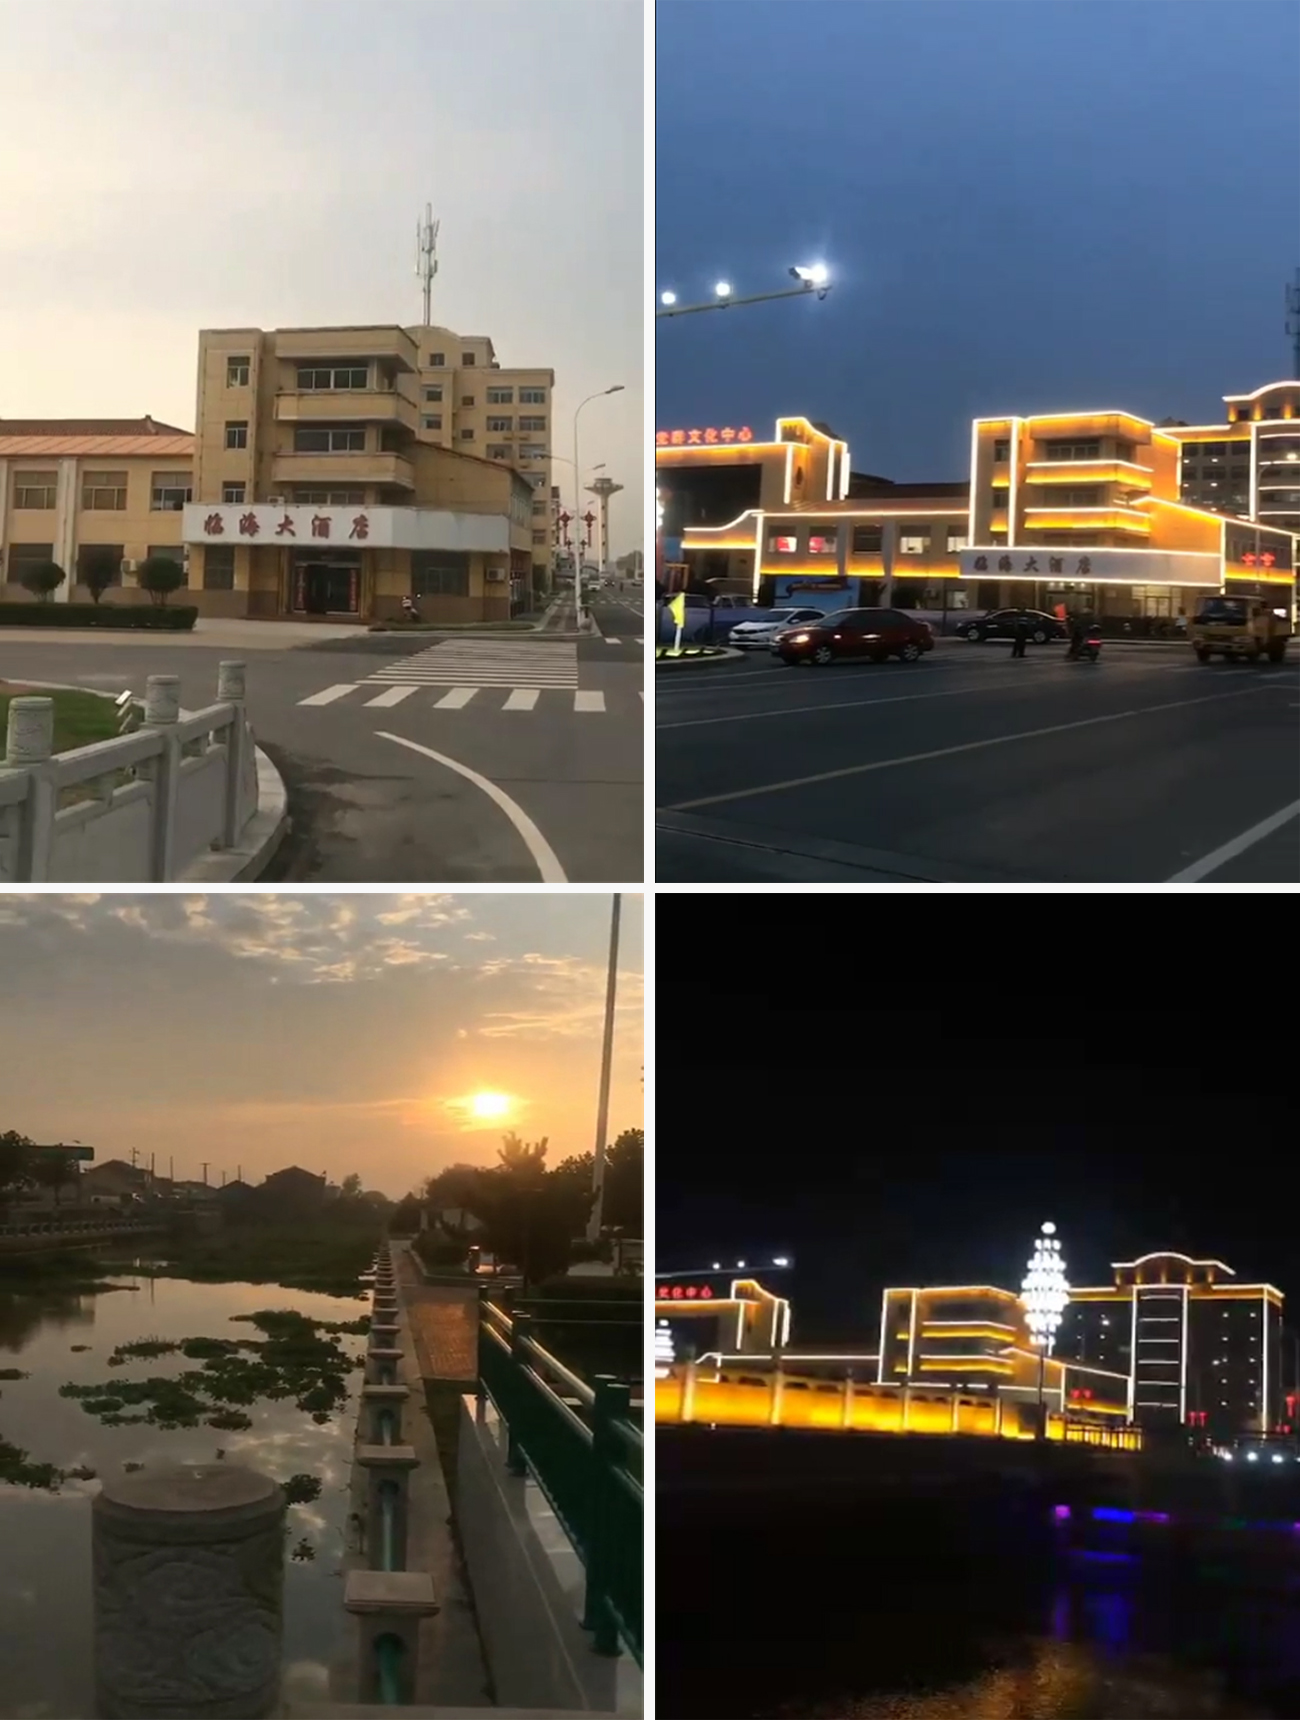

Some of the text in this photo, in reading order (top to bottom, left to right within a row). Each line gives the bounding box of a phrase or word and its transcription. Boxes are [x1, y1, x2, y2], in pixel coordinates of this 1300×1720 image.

[204, 511, 369, 540] 临海大酒店
